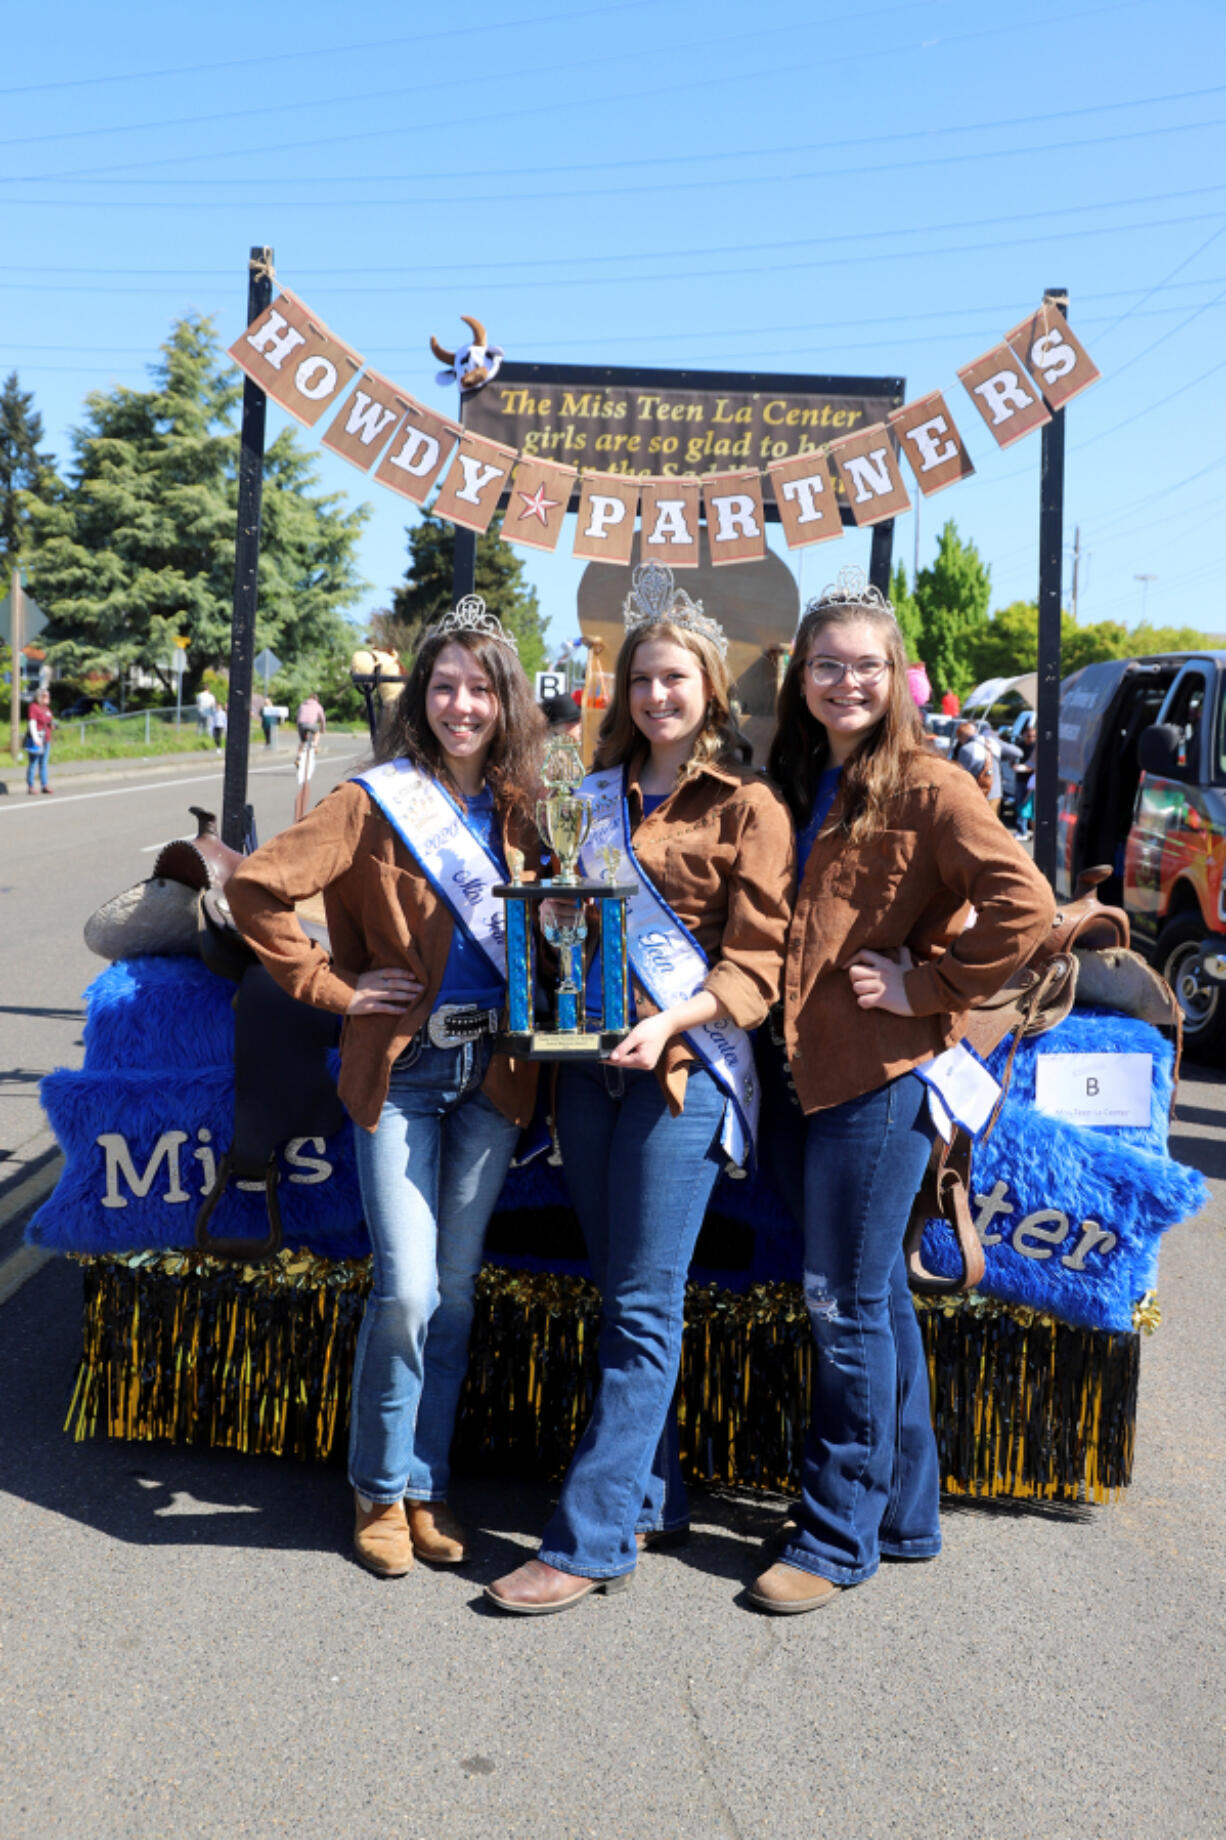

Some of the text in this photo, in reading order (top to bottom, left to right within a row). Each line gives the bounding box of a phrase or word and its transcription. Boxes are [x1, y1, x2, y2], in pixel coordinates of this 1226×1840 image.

[246, 309, 1079, 545] HOWDY PARTNERS
[501, 389, 863, 428] The Miss Teen La Center
[522, 424, 587, 455] girls
[595, 432, 642, 452] are
[648, 435, 679, 454] so
[684, 429, 753, 463] glad
[760, 435, 789, 458] to
[541, 676, 560, 700] B
[638, 930, 676, 974] Teen
[1086, 1077, 1100, 1096] B
[96, 1127, 333, 1208] Mis
